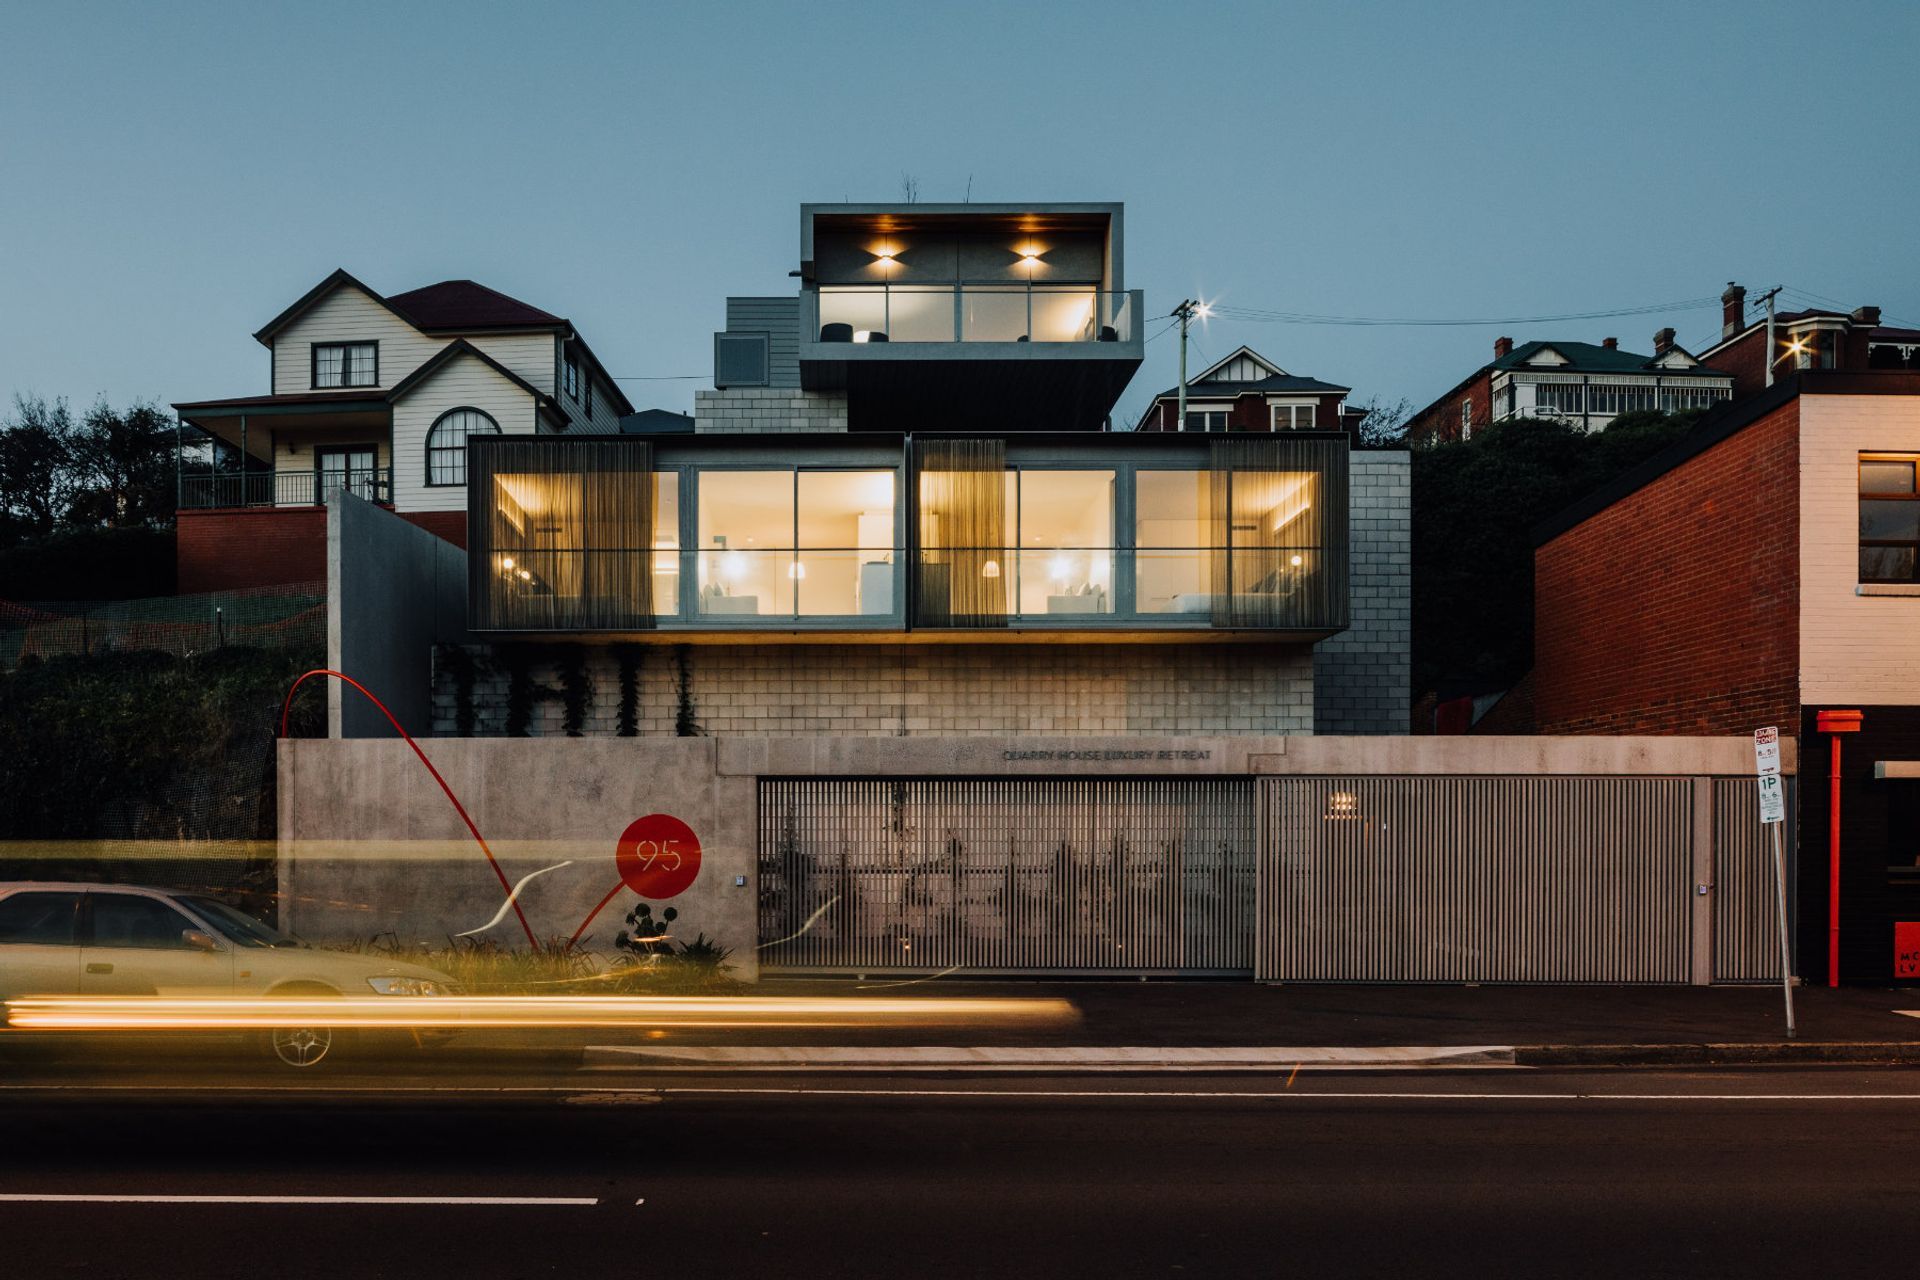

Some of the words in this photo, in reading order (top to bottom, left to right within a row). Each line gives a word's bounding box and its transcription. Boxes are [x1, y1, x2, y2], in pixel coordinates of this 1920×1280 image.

[1003, 750, 1054, 761] QUARRY
[1058, 750, 1101, 761] HOUSE
[1104, 750, 1153, 761] LUXURY
[1157, 750, 1211, 761] RETREAT
[1762, 777, 1777, 790] 1P
[636, 840, 681, 871] 95
